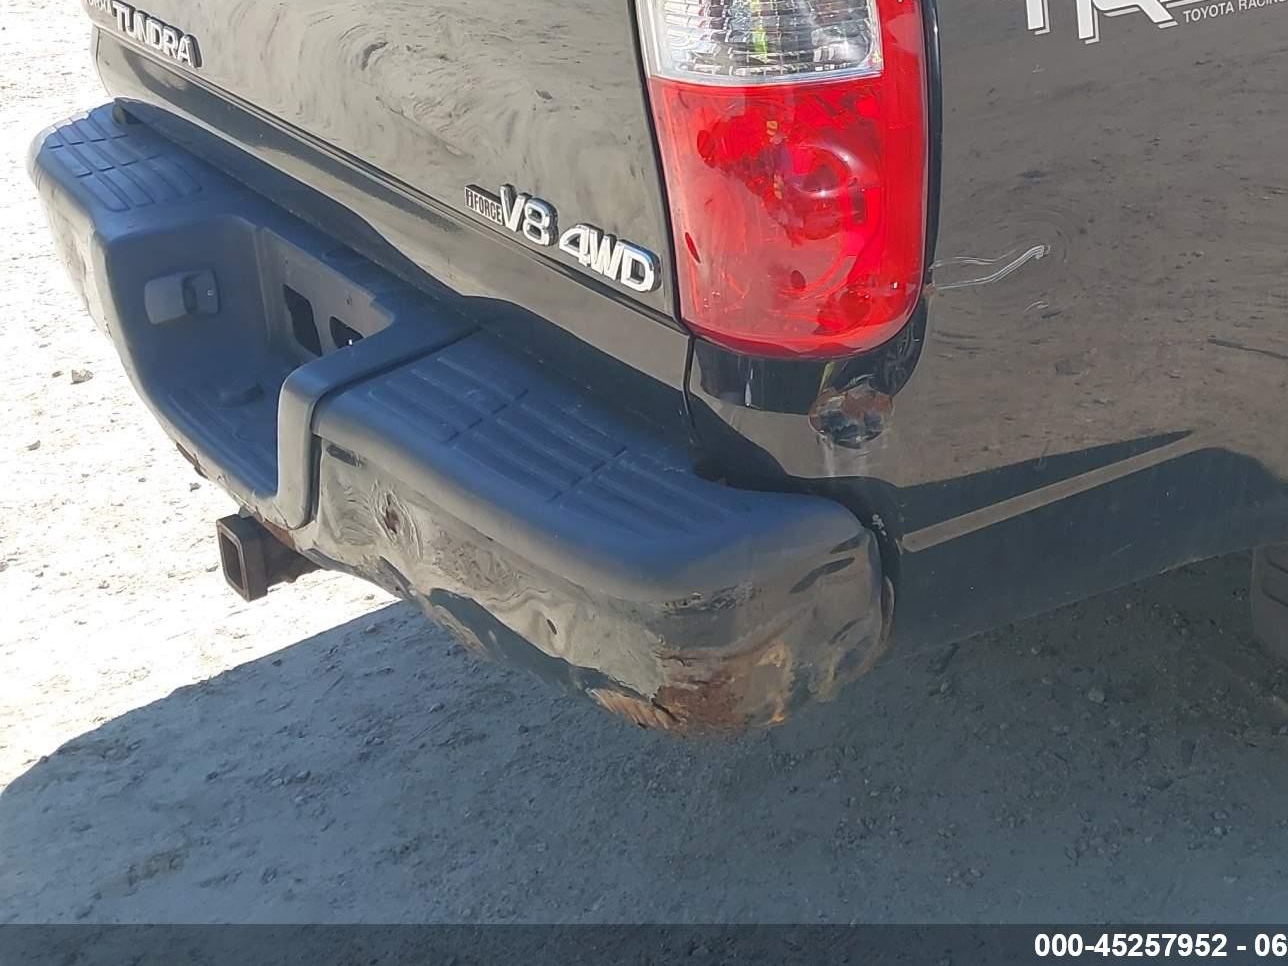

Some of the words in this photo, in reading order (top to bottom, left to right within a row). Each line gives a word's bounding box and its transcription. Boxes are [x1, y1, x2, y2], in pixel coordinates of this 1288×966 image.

[1183, 2, 1235, 23] TOYOTA
[500, 184, 558, 246] V8
[559, 223, 661, 292] 4WD
